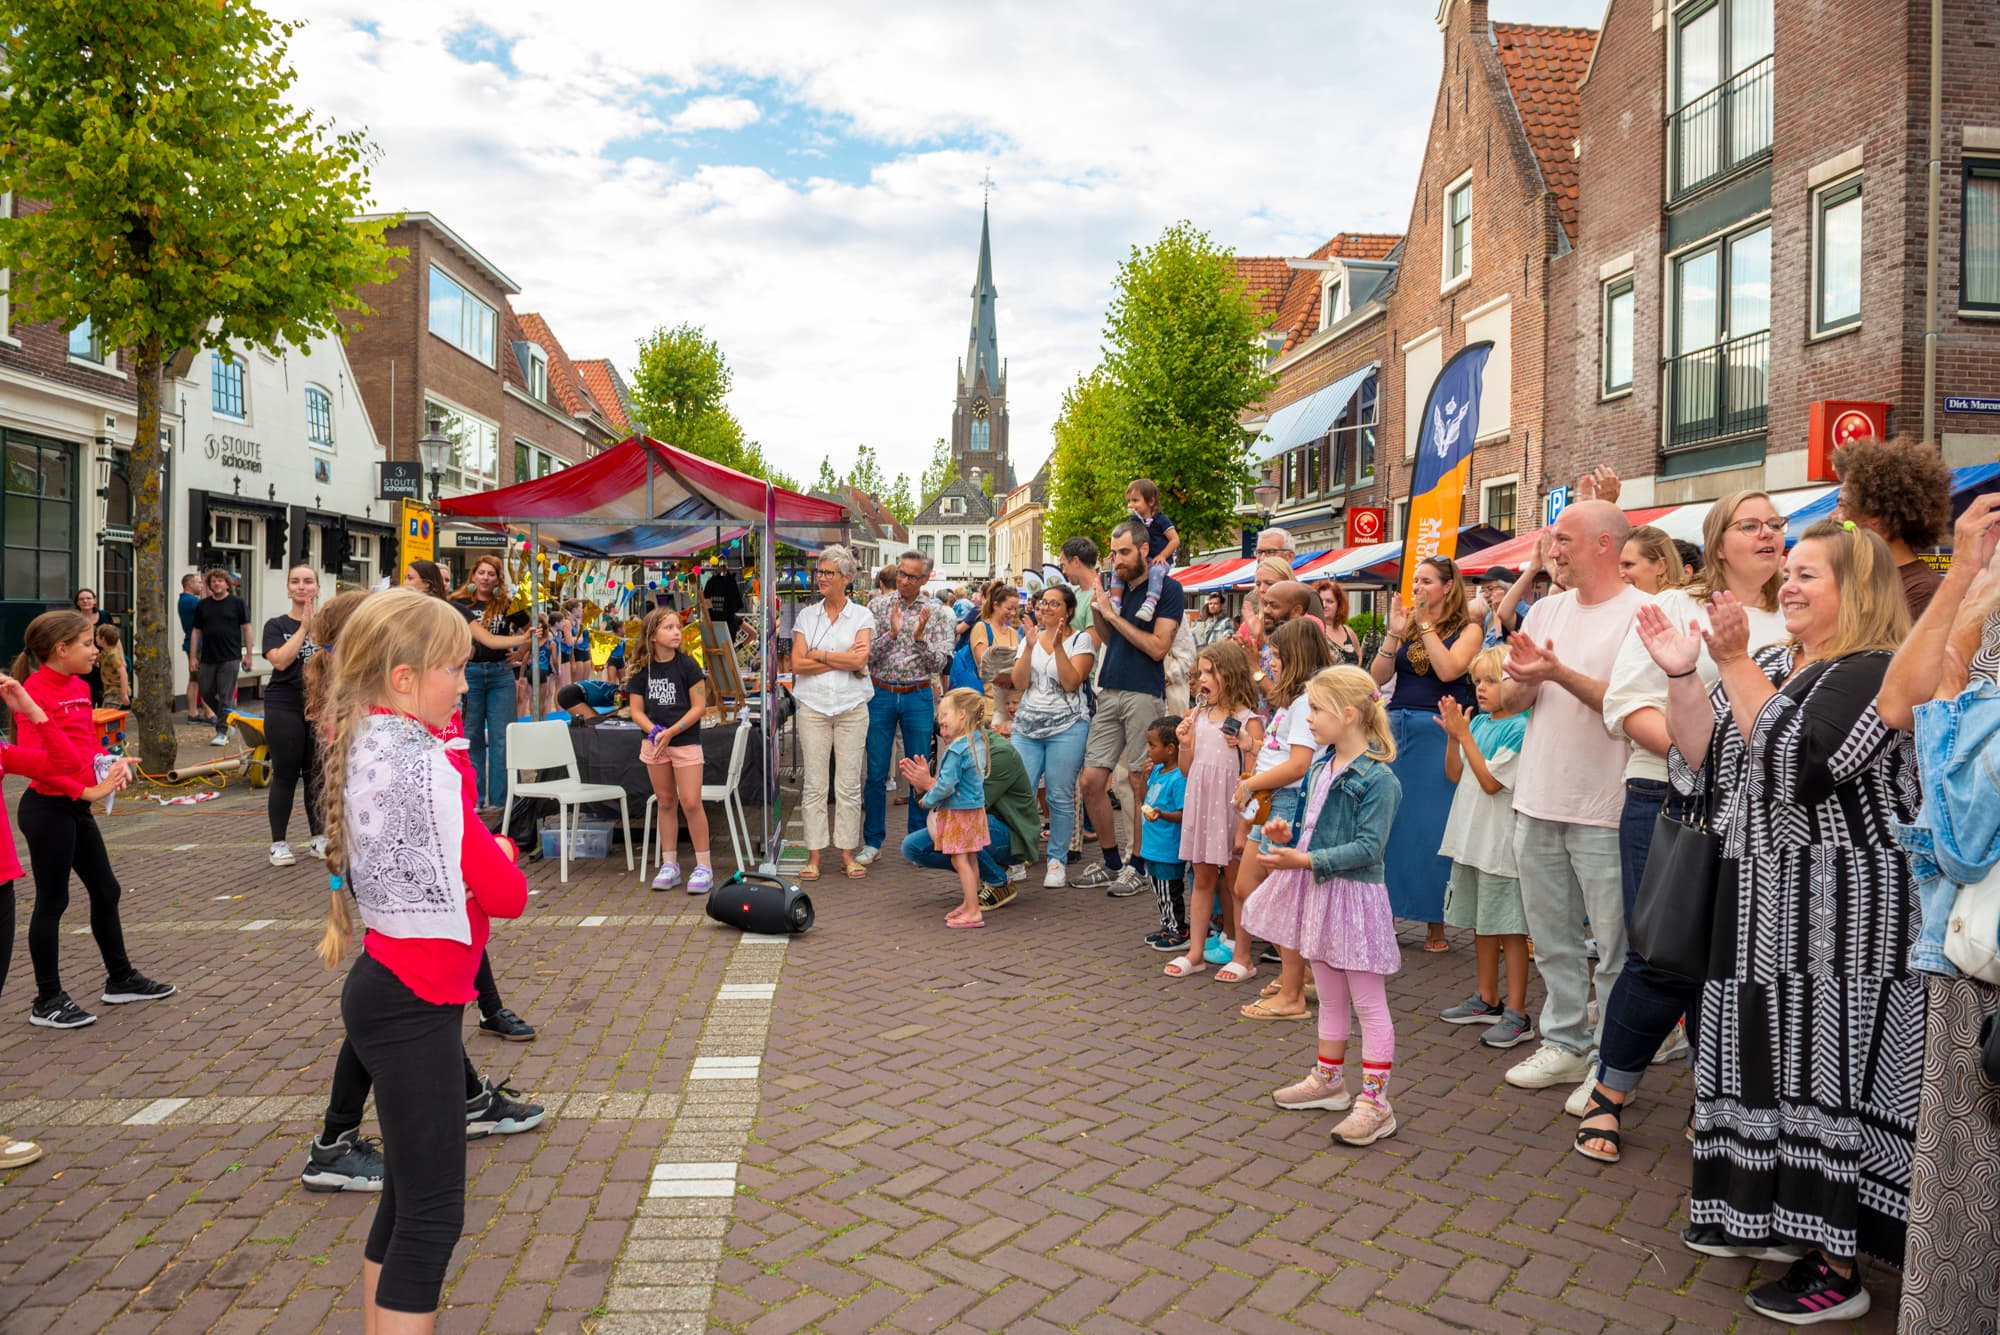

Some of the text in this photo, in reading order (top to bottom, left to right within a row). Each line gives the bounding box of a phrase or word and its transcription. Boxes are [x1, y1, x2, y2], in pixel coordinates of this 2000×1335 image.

[1949, 399, 1969, 409] Dirk
[222, 434, 262, 460] STOUTE
[222, 453, 262, 473] schoenen
[384, 478, 417, 487] STOUTE
[1552, 492, 1562, 520] P
[649, 682, 676, 692] YOUR
[648, 690, 676, 700] HEART
